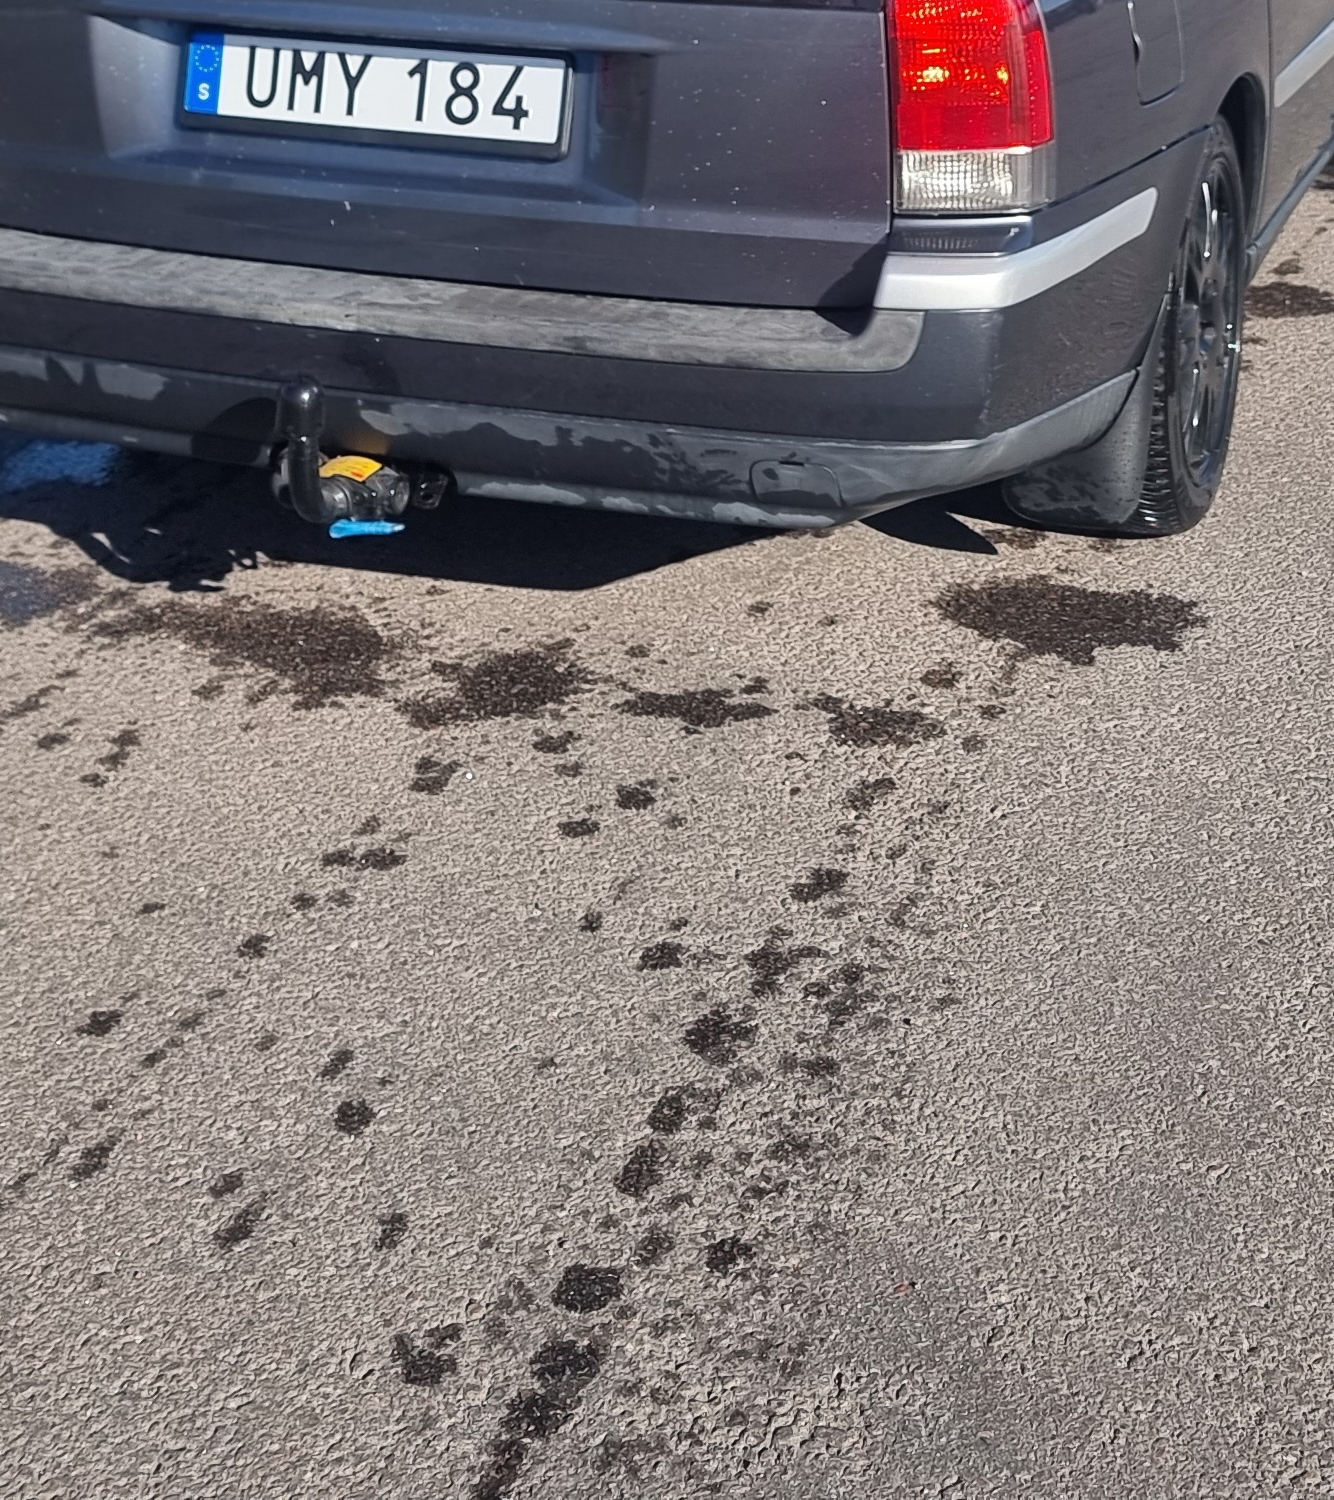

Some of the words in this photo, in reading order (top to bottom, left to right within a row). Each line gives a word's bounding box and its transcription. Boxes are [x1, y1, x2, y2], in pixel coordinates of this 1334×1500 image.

[197, 82, 211, 101] S
[245, 45, 374, 117] UMY
[406, 58, 530, 131] 184
